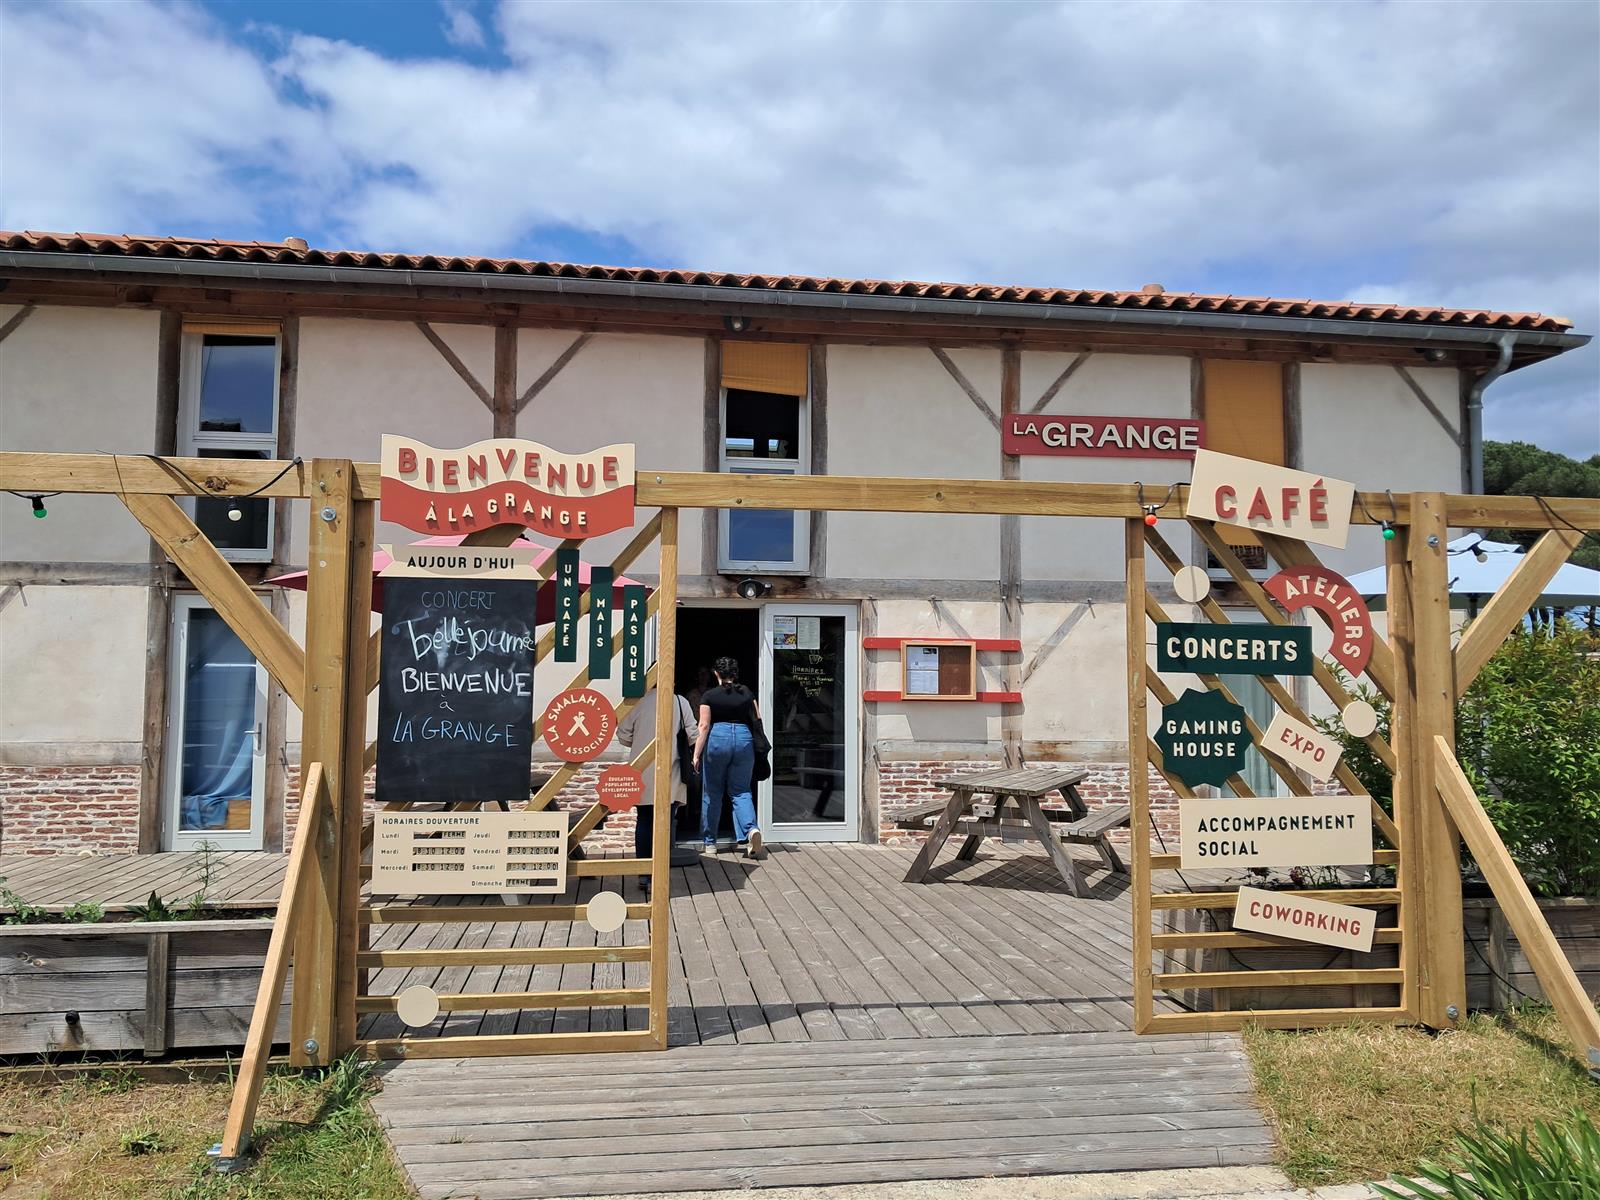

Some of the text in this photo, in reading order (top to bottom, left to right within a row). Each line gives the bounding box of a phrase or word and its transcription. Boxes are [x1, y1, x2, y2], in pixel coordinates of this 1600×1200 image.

[1013, 422, 1200, 450] LA GRANGE
[398, 447, 618, 490] BIENVENUE
[425, 493, 587, 526] À LA GRANGE
[1214, 478, 1328, 522] CAFÉ
[407, 555, 515, 569] AUJOUR D'HUI
[421, 591, 496, 610] CONCERT
[562, 564, 572, 647] UN CAFÉ
[1285, 574, 1364, 659] ATELIERS
[596, 599, 605, 647] MAIS
[630, 599, 638, 681] PAS QUE
[1166, 636, 1298, 662] CONCERTS
[401, 667, 531, 697] BIENVENUE
[392, 712, 519, 747] LA GRANGE
[547, 694, 598, 742] LA SMALAH
[565, 714, 609, 755] ASSOCIATION
[1166, 719, 1242, 735] GAMING
[1173, 742, 1237, 757] HOUSE
[1280, 727, 1326, 764] EXPO
[1197, 814, 1356, 833] ACCOMPAGNEMENT
[1198, 840, 1259, 857] SOCIAL
[1249, 900, 1362, 937] COWORKING
